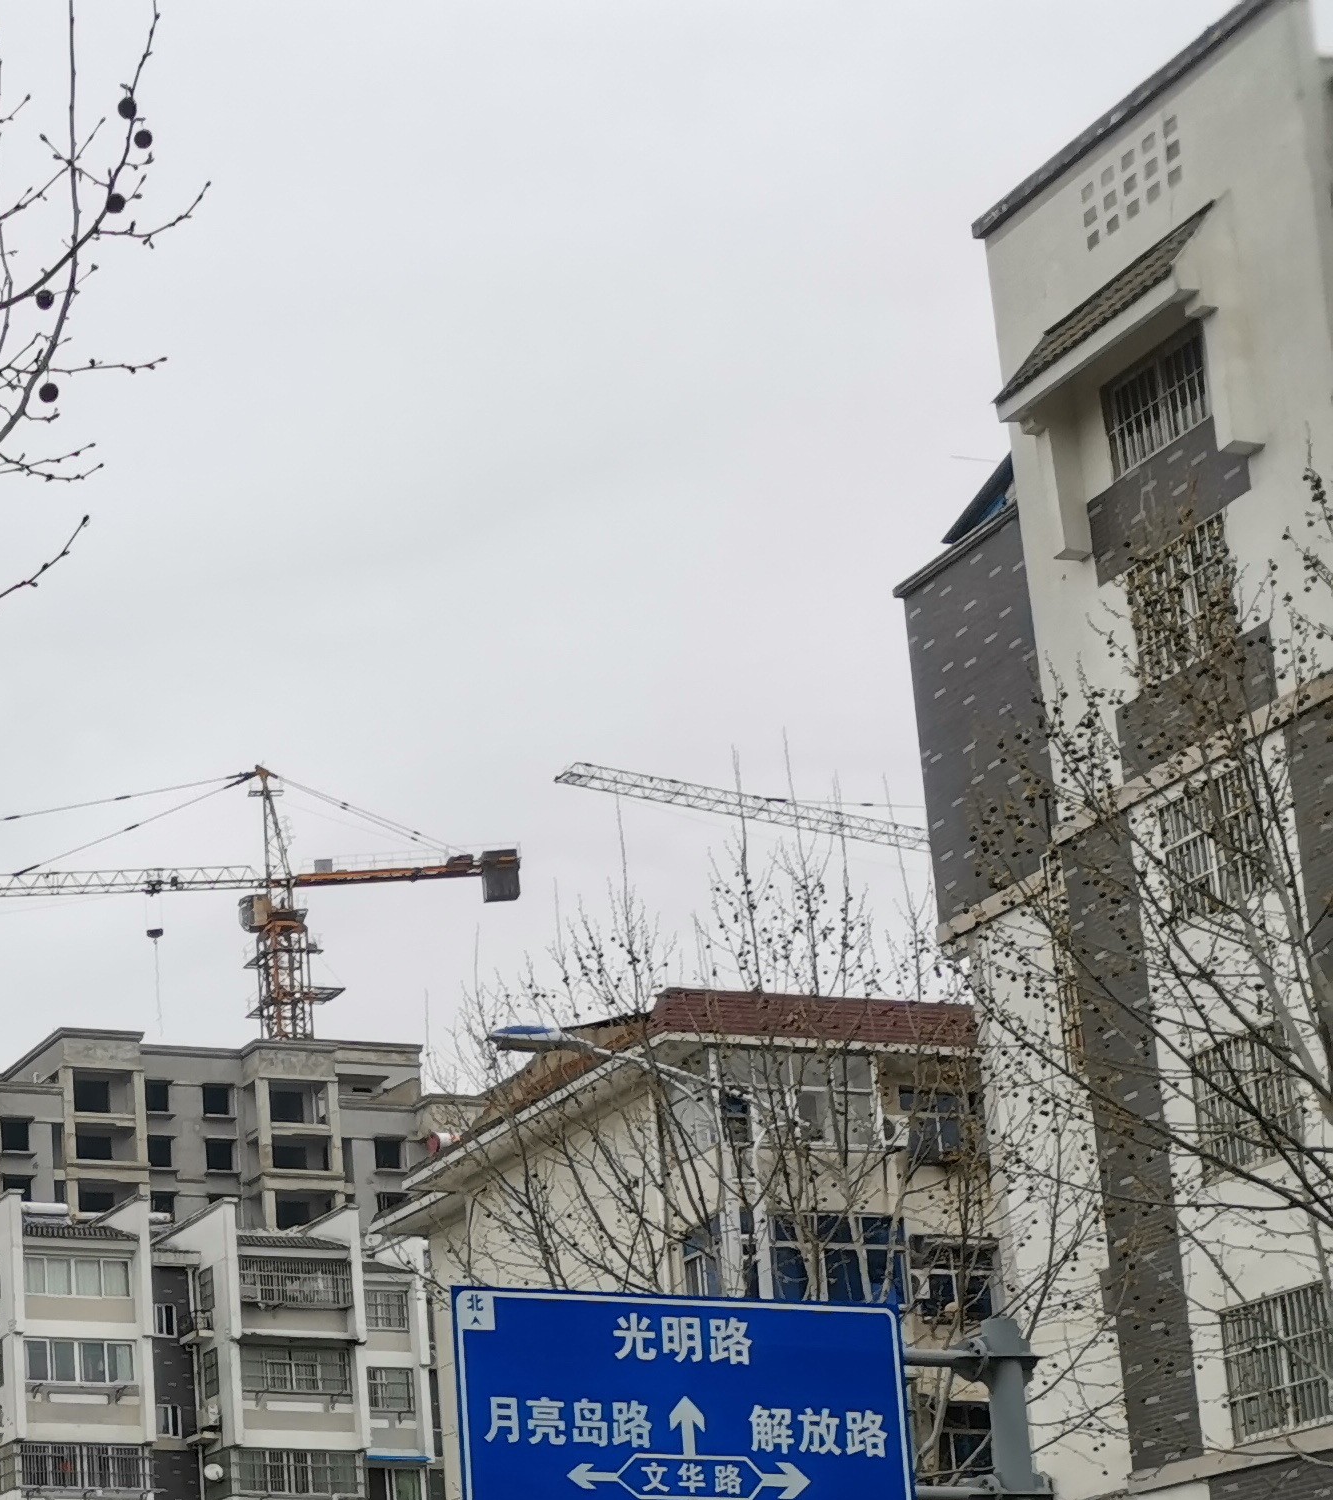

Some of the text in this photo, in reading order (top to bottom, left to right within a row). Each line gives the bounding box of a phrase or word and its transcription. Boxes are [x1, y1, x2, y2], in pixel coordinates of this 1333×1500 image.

[466, 1294, 484, 1313] 北
[613, 1312, 753, 1365] 光明路
[484, 1396, 653, 1448] 月亮岛路
[748, 1404, 889, 1459] 解放路
[641, 1462, 743, 1495] 文华路
